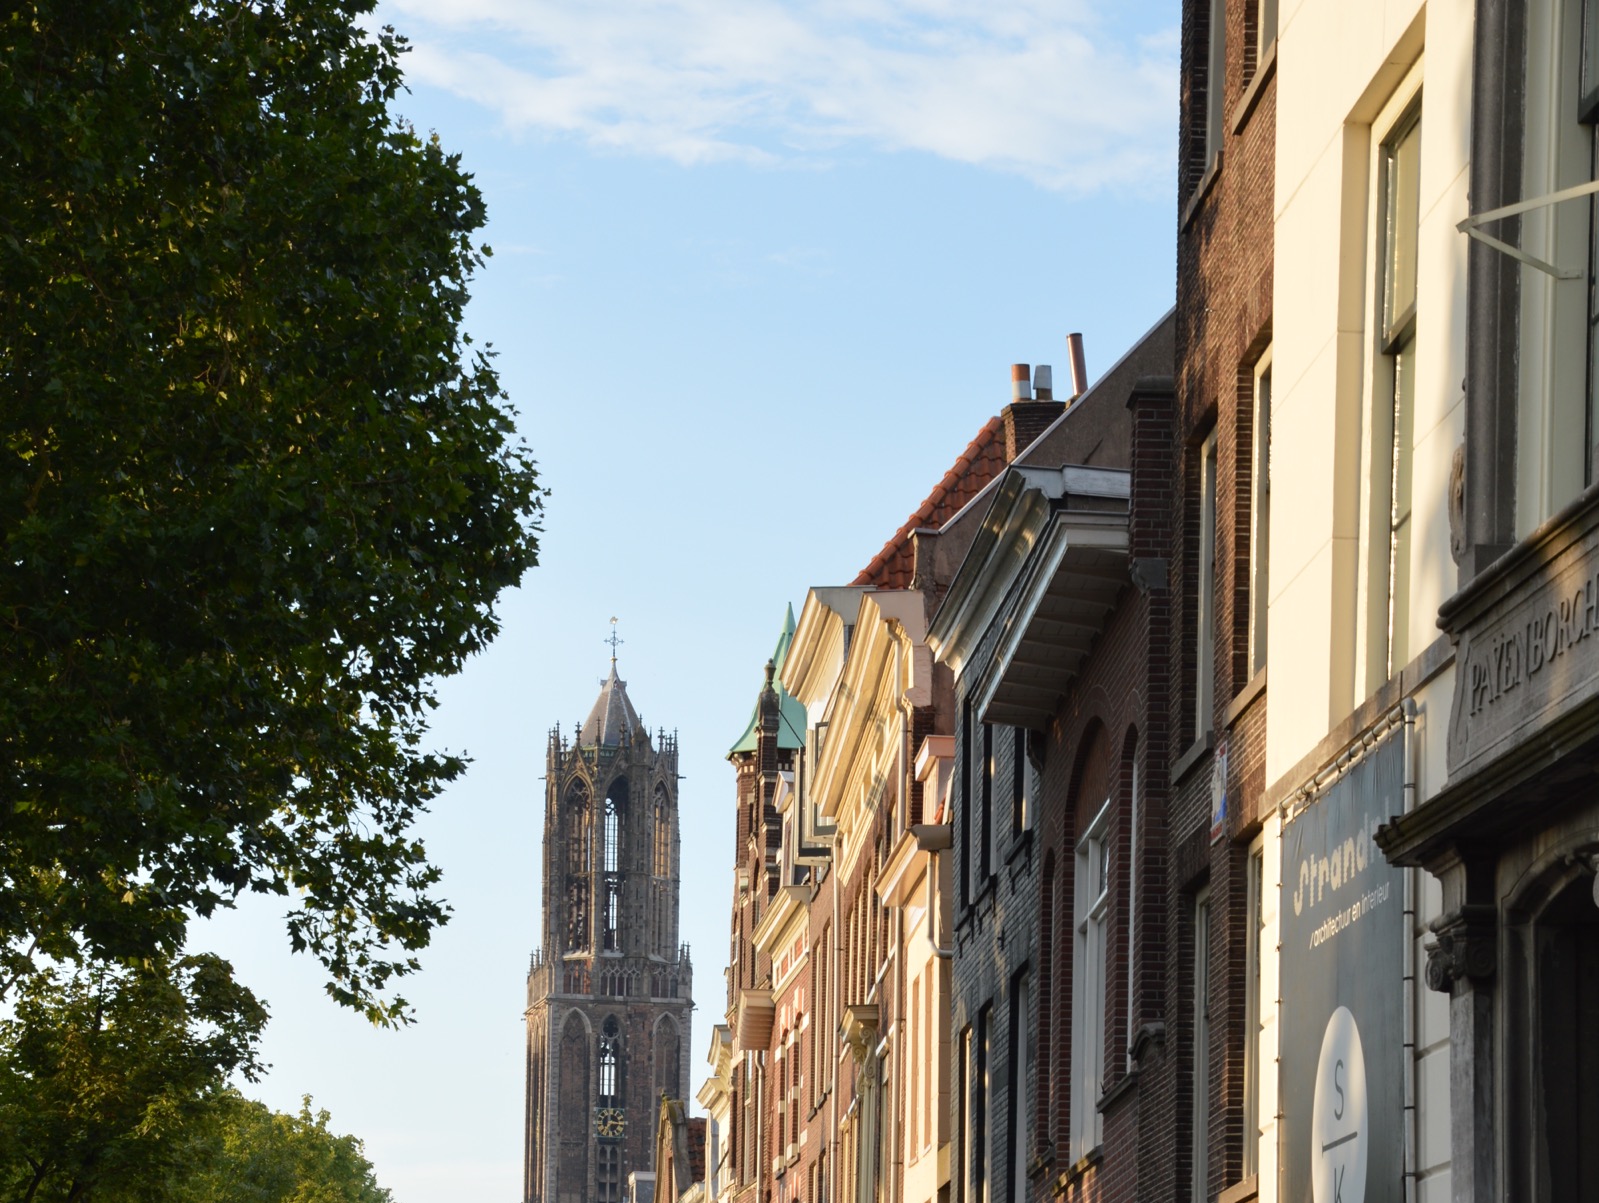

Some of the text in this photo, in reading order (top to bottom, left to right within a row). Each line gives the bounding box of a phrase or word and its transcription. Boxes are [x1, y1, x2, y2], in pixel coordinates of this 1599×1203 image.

[1351, 901, 1361, 922] en
[1361, 881, 1390, 914] interieur
[1334, 1058, 1345, 1121] S
